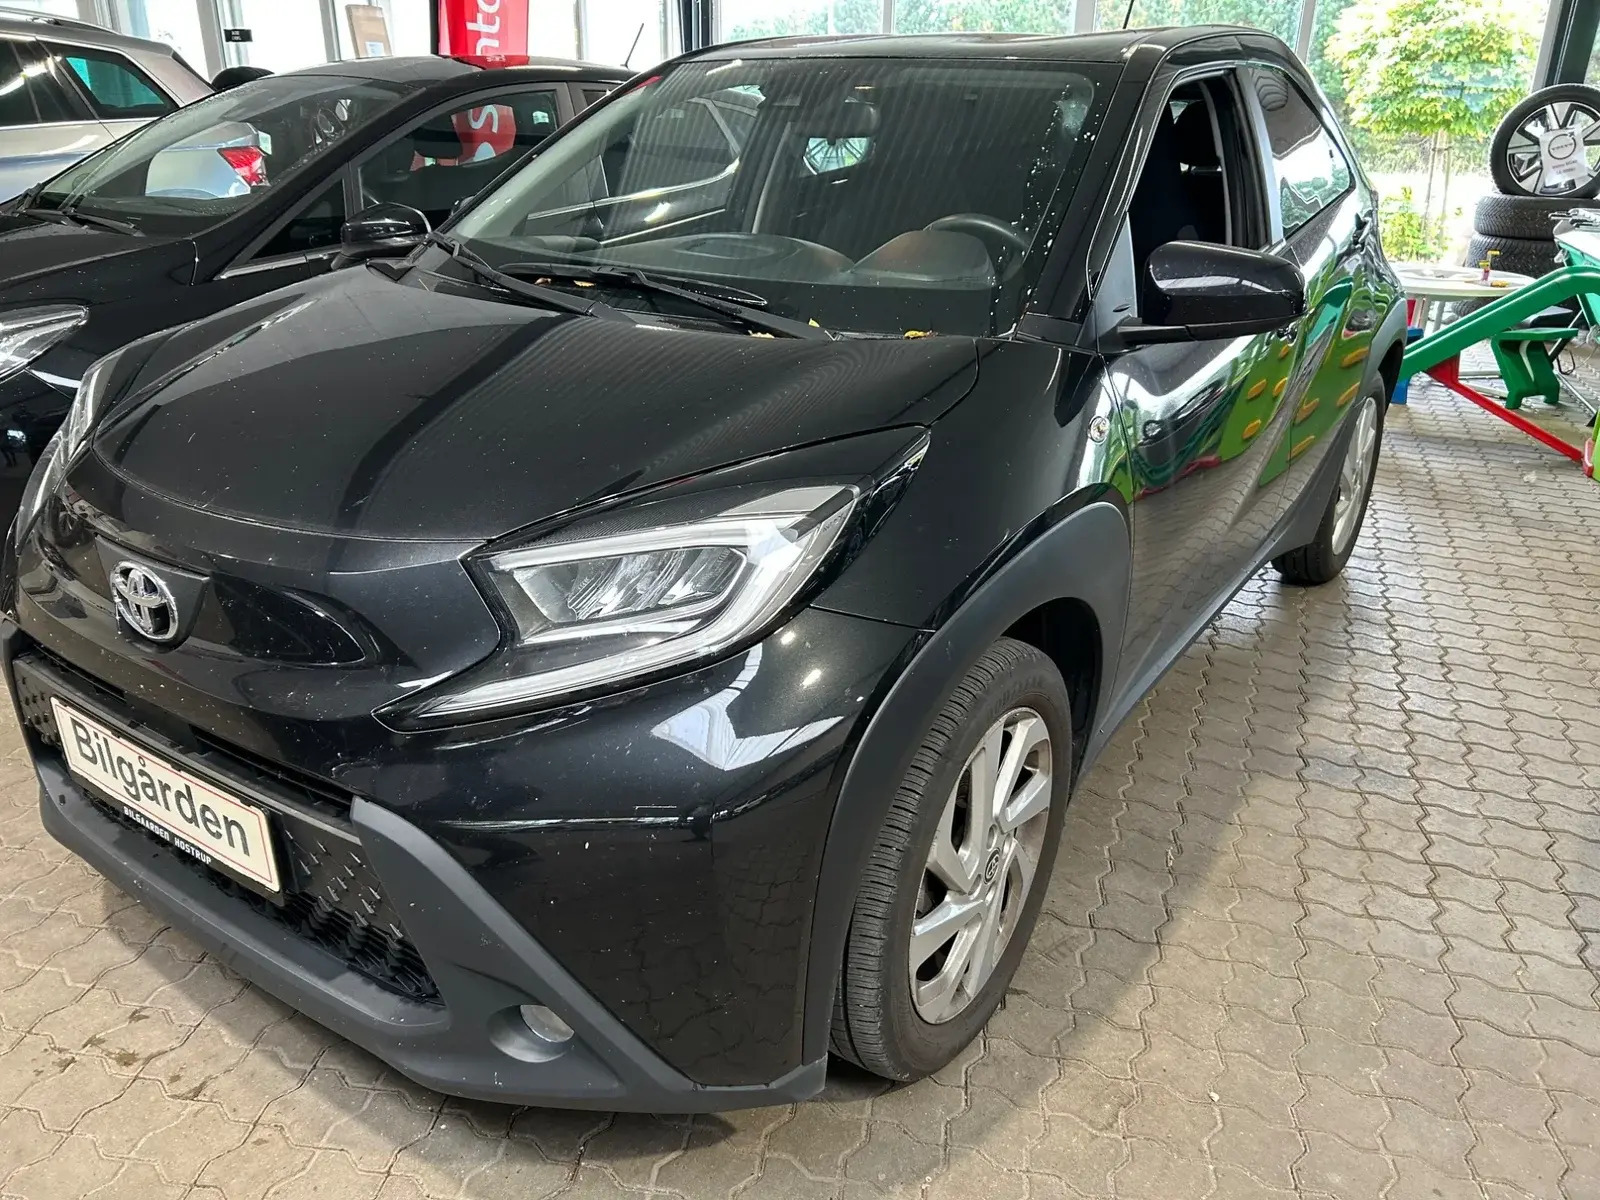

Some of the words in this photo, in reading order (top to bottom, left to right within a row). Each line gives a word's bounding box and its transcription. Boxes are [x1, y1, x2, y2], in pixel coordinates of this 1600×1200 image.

[70, 717, 250, 857] Bilgården
[123, 806, 170, 842] BILGAARDEN
[174, 837, 212, 865] HOSTRUP
